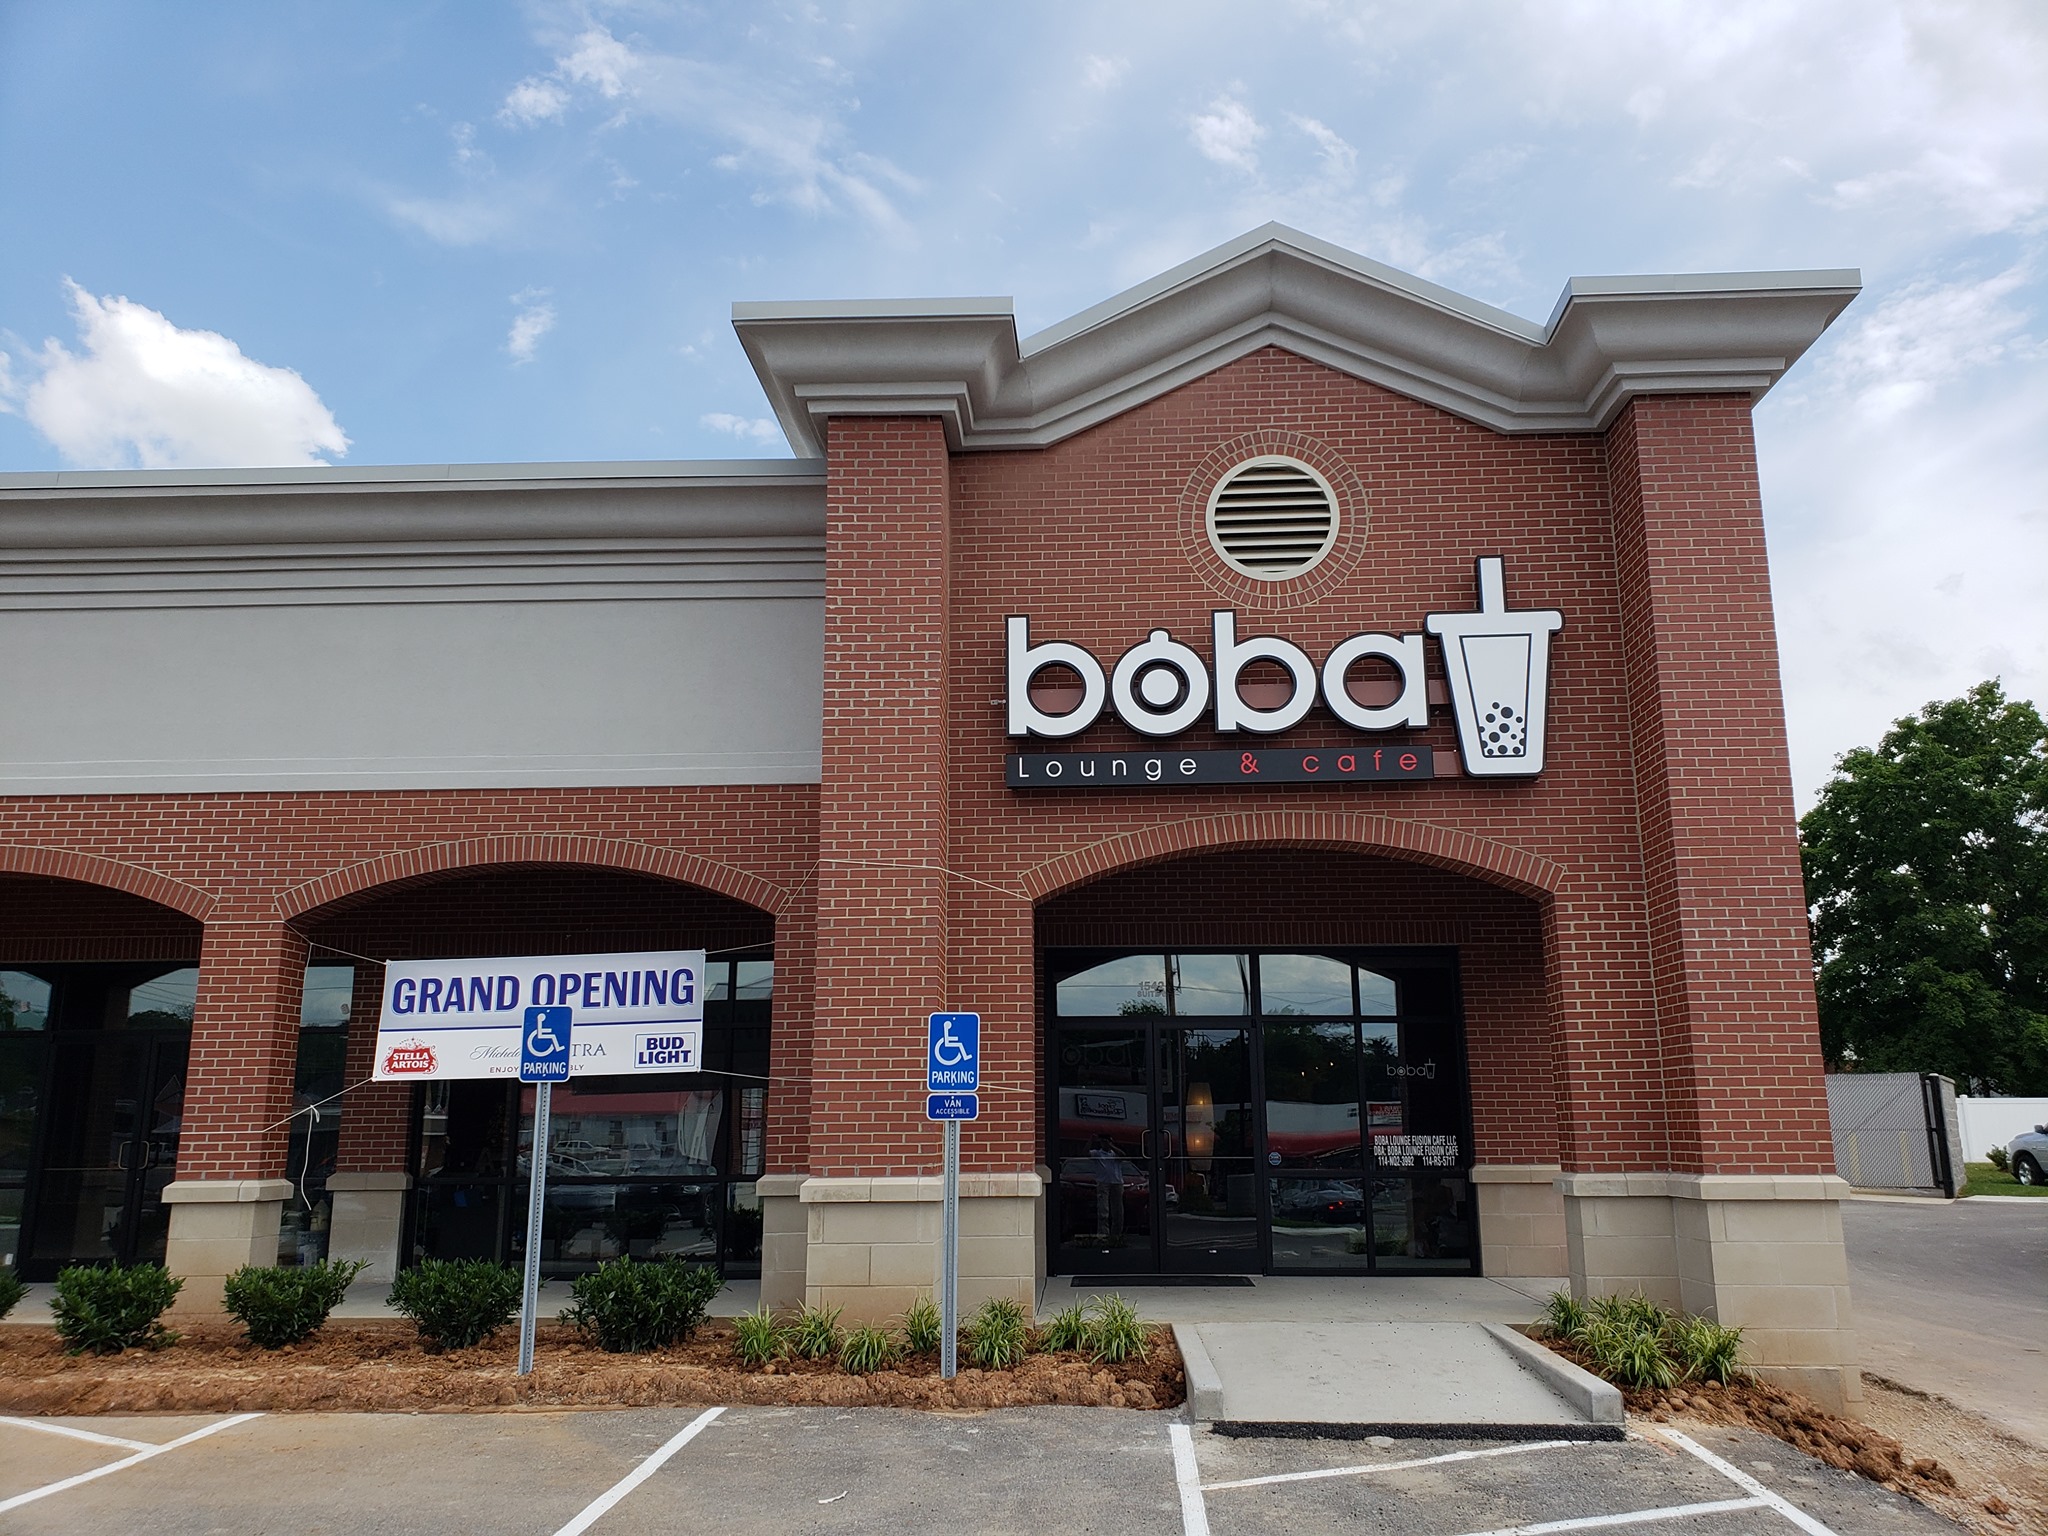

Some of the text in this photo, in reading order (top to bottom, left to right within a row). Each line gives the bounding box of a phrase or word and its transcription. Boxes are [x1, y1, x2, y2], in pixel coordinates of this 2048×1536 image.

[1006, 610, 1430, 738] boba
[1018, 749, 1418, 783] Lounge & cafe
[392, 967, 695, 1015] GRAND OPENING
[646, 1036, 685, 1051] BUD
[392, 1052, 429, 1061] STELLA
[469, 1043, 606, 1060] Michelo TRA
[638, 1049, 692, 1065] LIGHT
[391, 1060, 429, 1069] ARTOIS
[489, 1066, 519, 1074] ENJOY
[523, 1061, 567, 1075] PARKING
[1386, 1064, 1426, 1076] boba
[931, 1070, 975, 1084] PARKING
[944, 1099, 962, 1108] VAN
[1374, 1135, 1457, 1146] BOBA LOUNGE FUSION CAFE LLC
[1387, 1145, 1402, 1156] BOBA
[1402, 1145, 1424, 1156] LOUNGE
[1424, 1145, 1445, 1156] FUSION
[1445, 1145, 1459, 1156] CAFE
